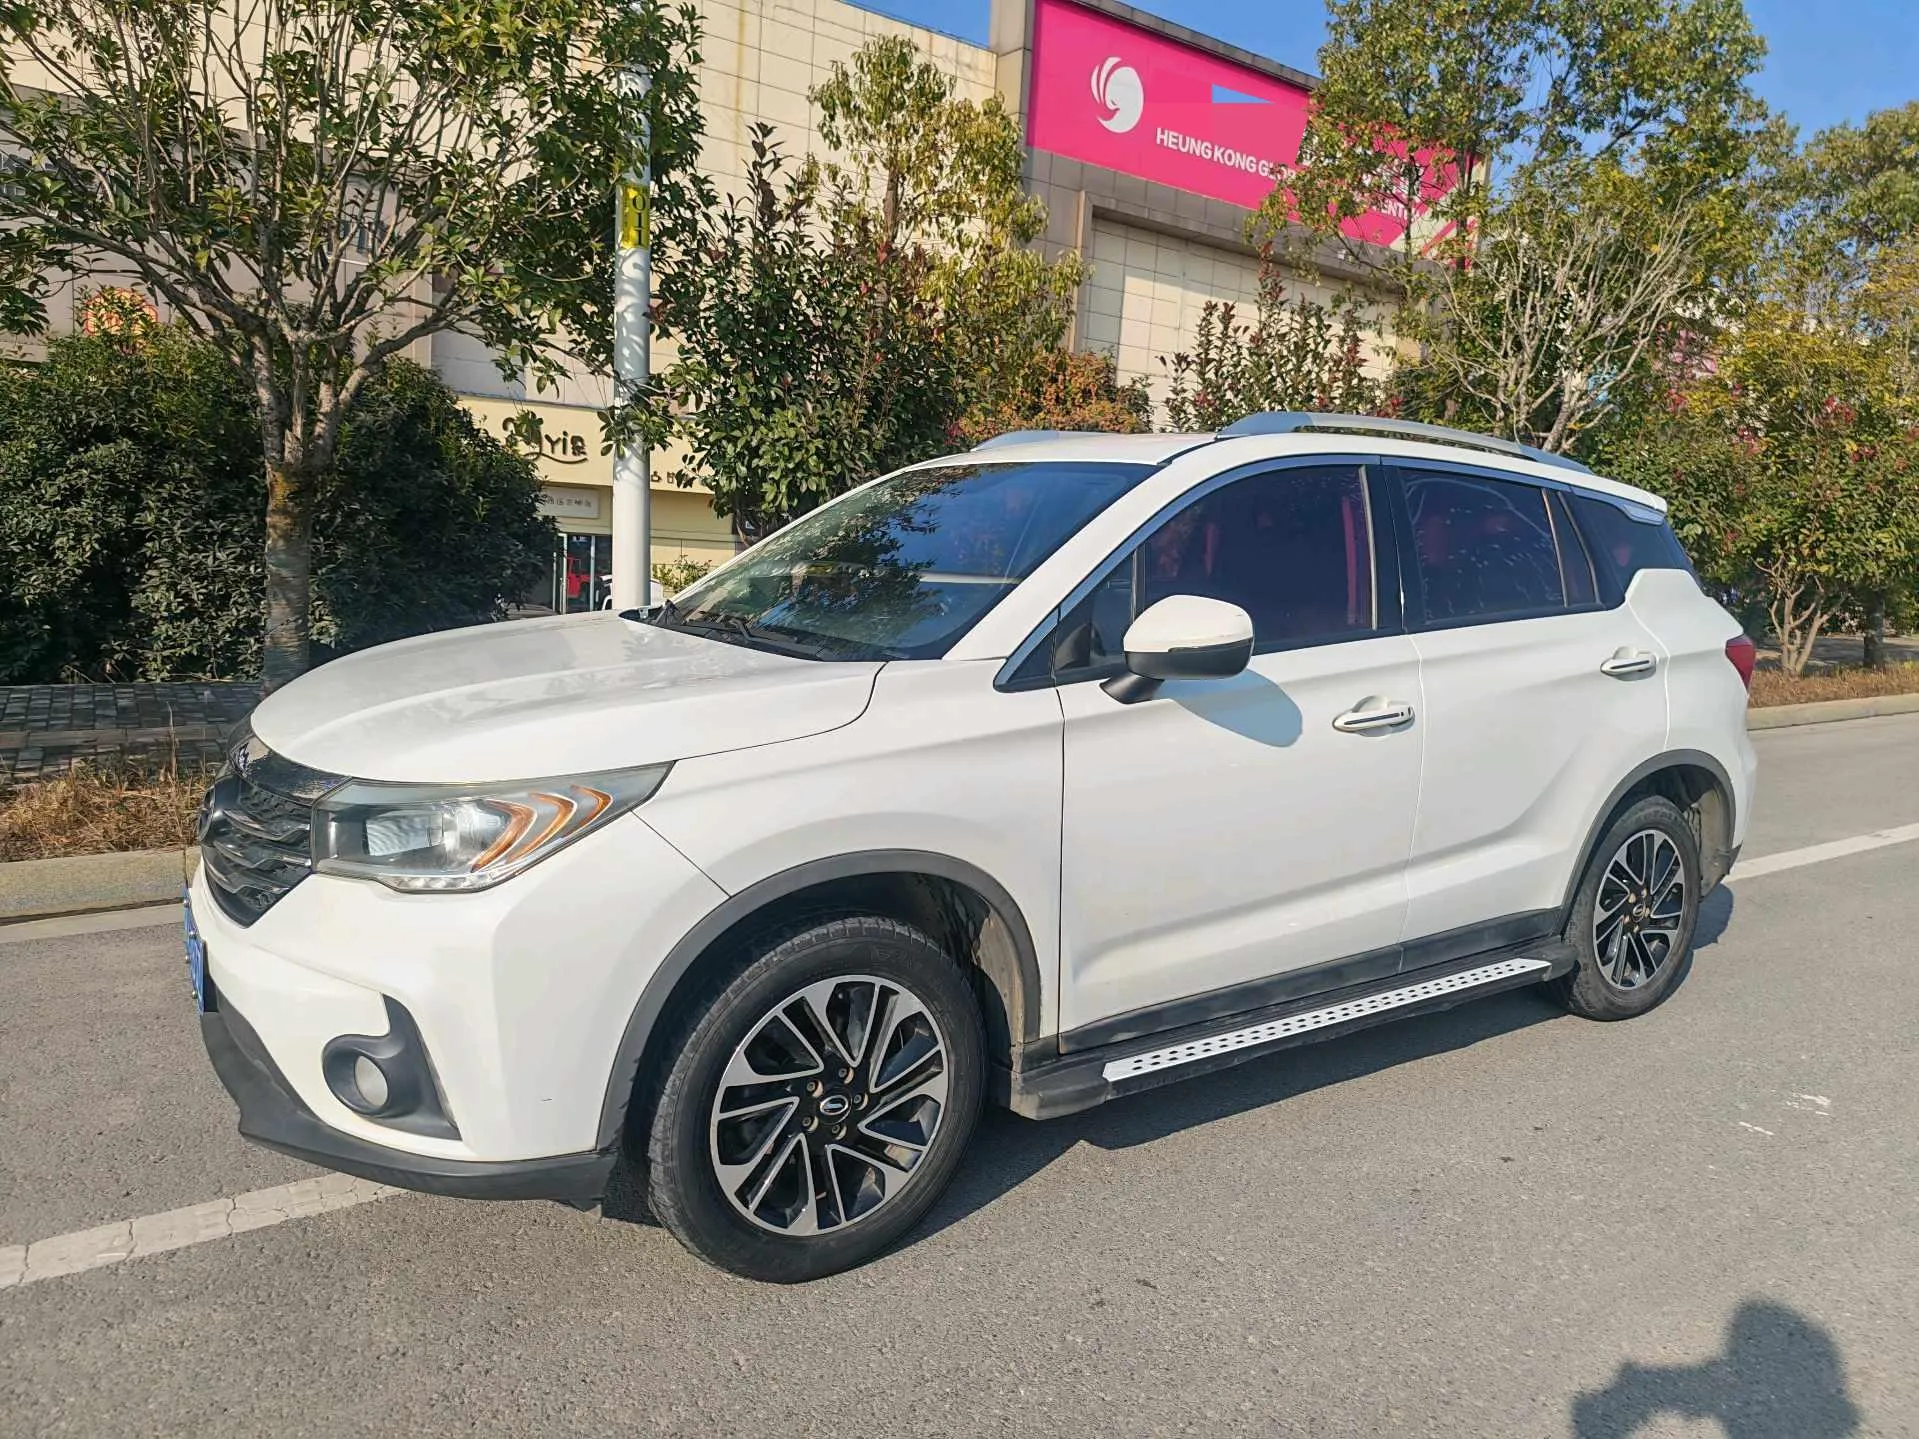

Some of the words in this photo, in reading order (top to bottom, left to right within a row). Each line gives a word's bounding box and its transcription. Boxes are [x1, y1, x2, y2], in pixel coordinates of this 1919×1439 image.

[1156, 127, 1212, 160] HEUNG
[1213, 144, 1257, 173] KONG
[1258, 159, 1297, 182] GLOB
